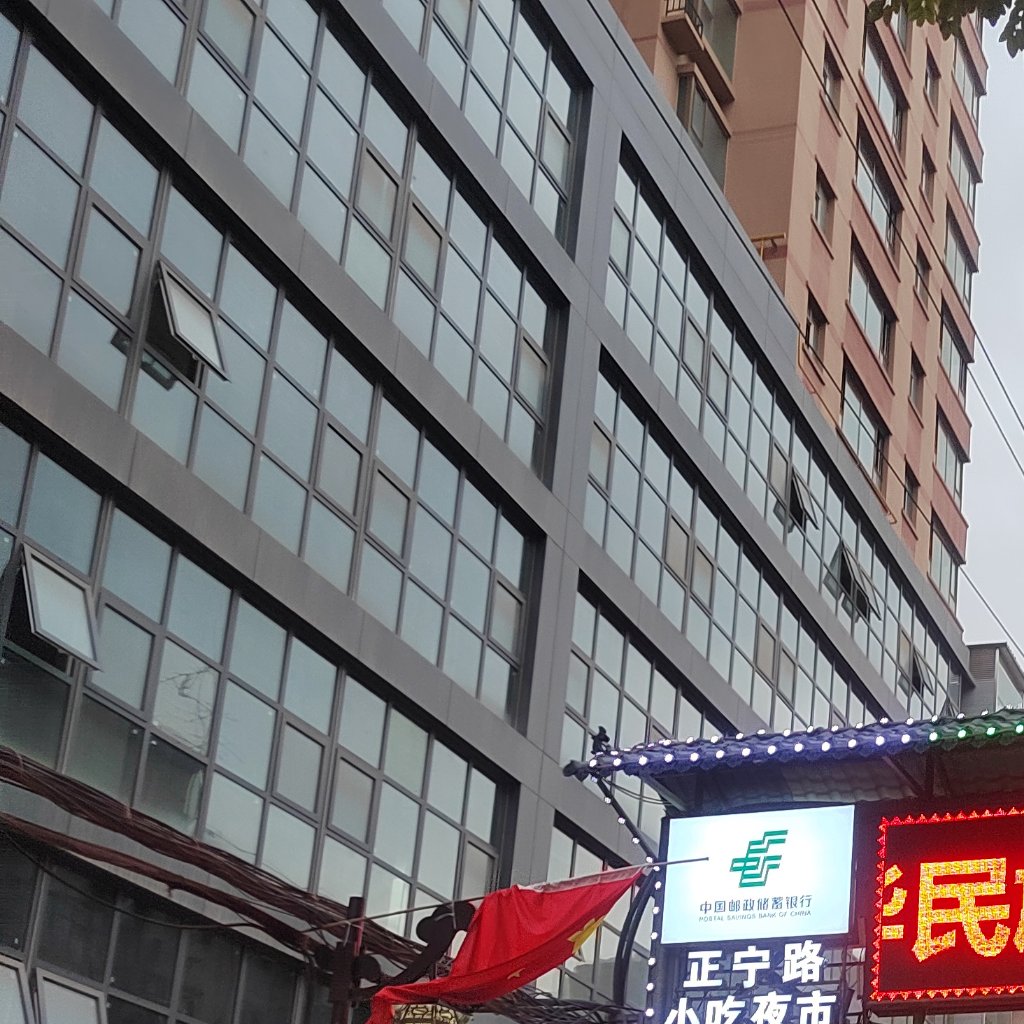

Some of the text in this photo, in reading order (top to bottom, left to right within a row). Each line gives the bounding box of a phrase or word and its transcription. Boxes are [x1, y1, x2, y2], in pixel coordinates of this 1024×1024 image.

[699, 894, 812, 915] 中国邮政储蓄银行
[727, 913, 756, 921] SAVINGS
[683, 939, 826, 989] 正宁路
